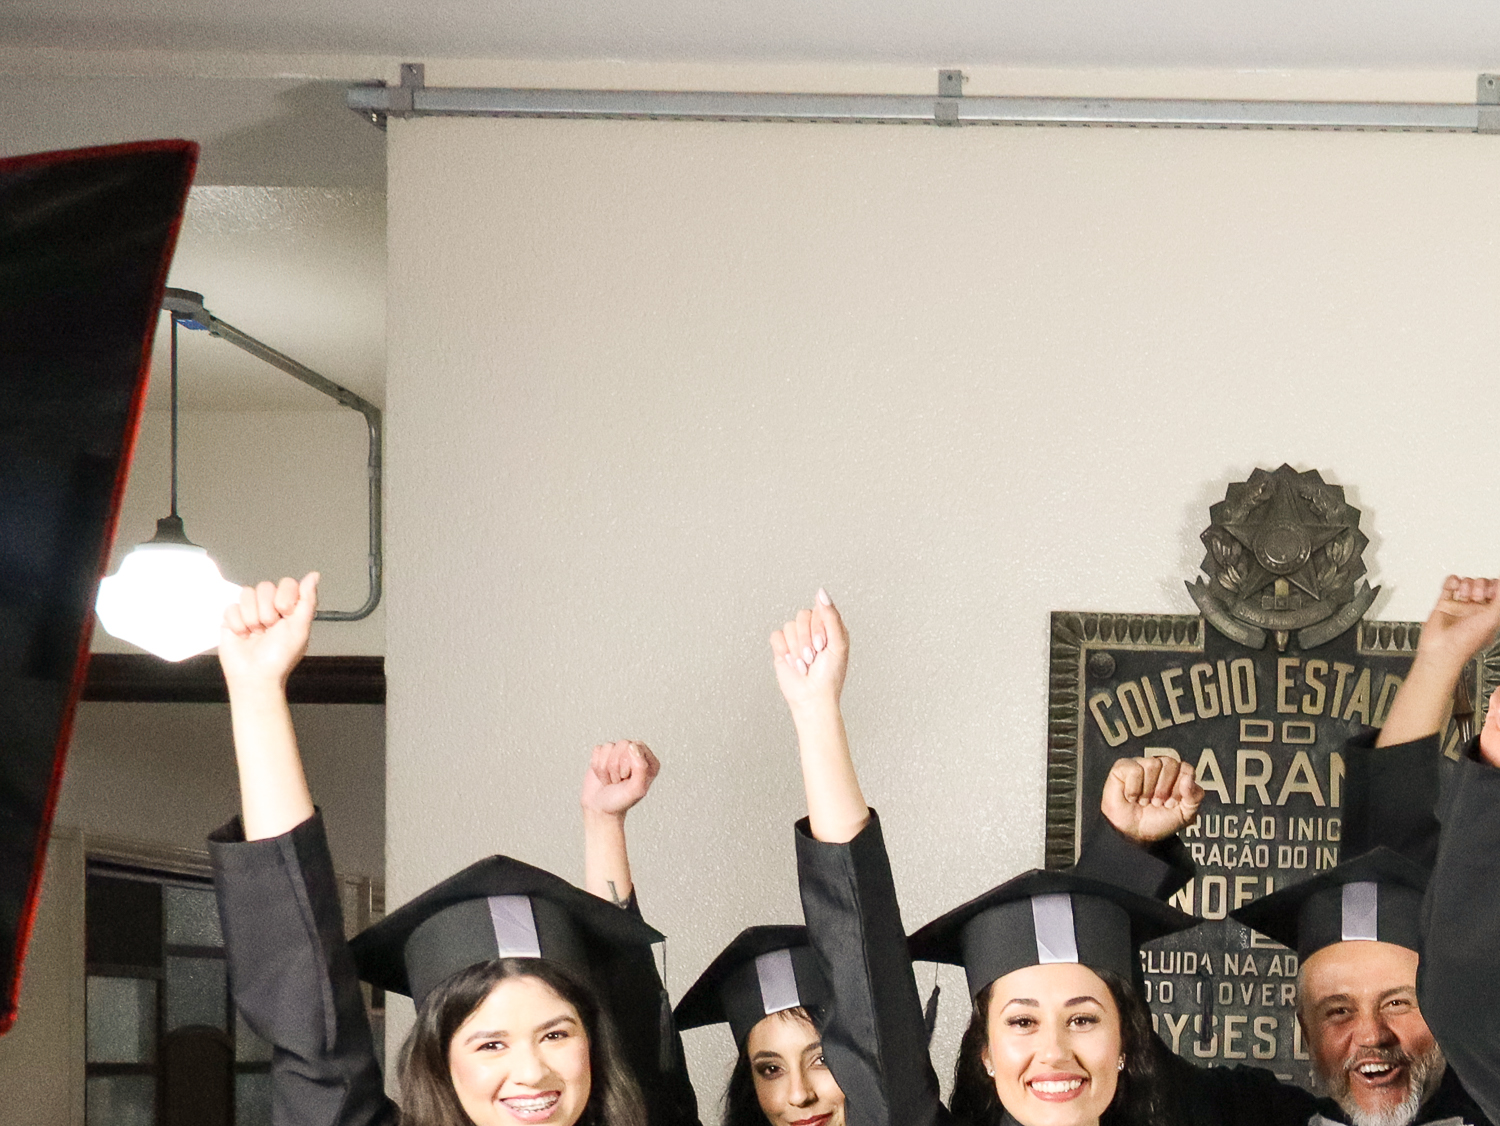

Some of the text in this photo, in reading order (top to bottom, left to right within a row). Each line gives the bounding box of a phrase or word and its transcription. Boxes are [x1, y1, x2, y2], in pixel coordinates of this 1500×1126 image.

[1088, 657, 1257, 747] COLEGIO
[1239, 718, 1316, 745] DO
[1184, 840, 1270, 870] RAÇÃO
[1277, 844, 1308, 870] DO
[1224, 952, 1259, 977] NA
[1151, 1012, 1278, 1061] YSES
